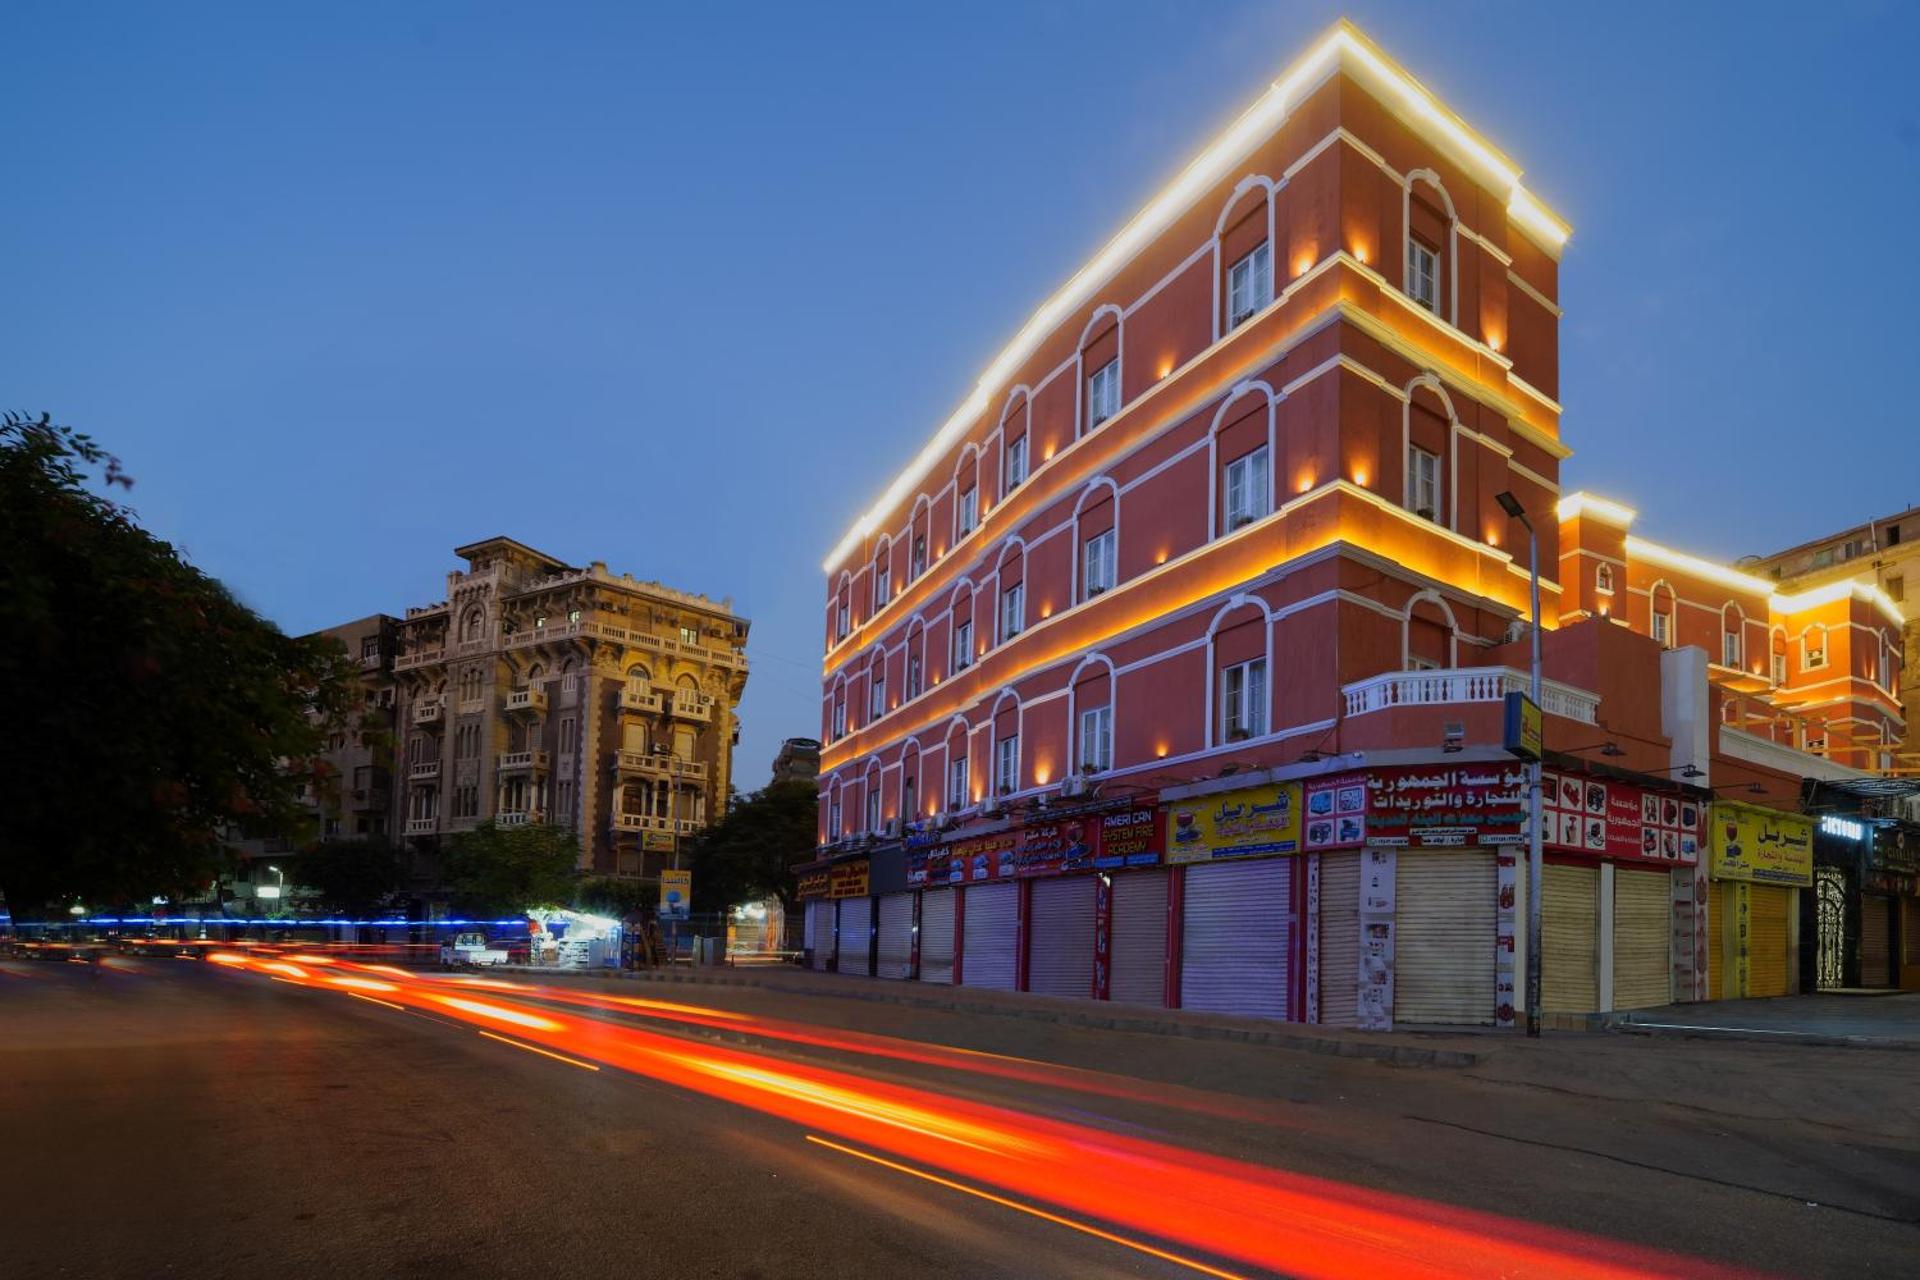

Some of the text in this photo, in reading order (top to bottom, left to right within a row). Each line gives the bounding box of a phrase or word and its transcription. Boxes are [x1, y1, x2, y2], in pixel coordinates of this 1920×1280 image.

[1366, 767, 1527, 792] مؤسسة الجمهورية
[1373, 789, 1524, 810] للتجارة والتوريدات
[1104, 809, 1152, 828] AMERICAN
[1606, 812, 1642, 828] الجمهورية
